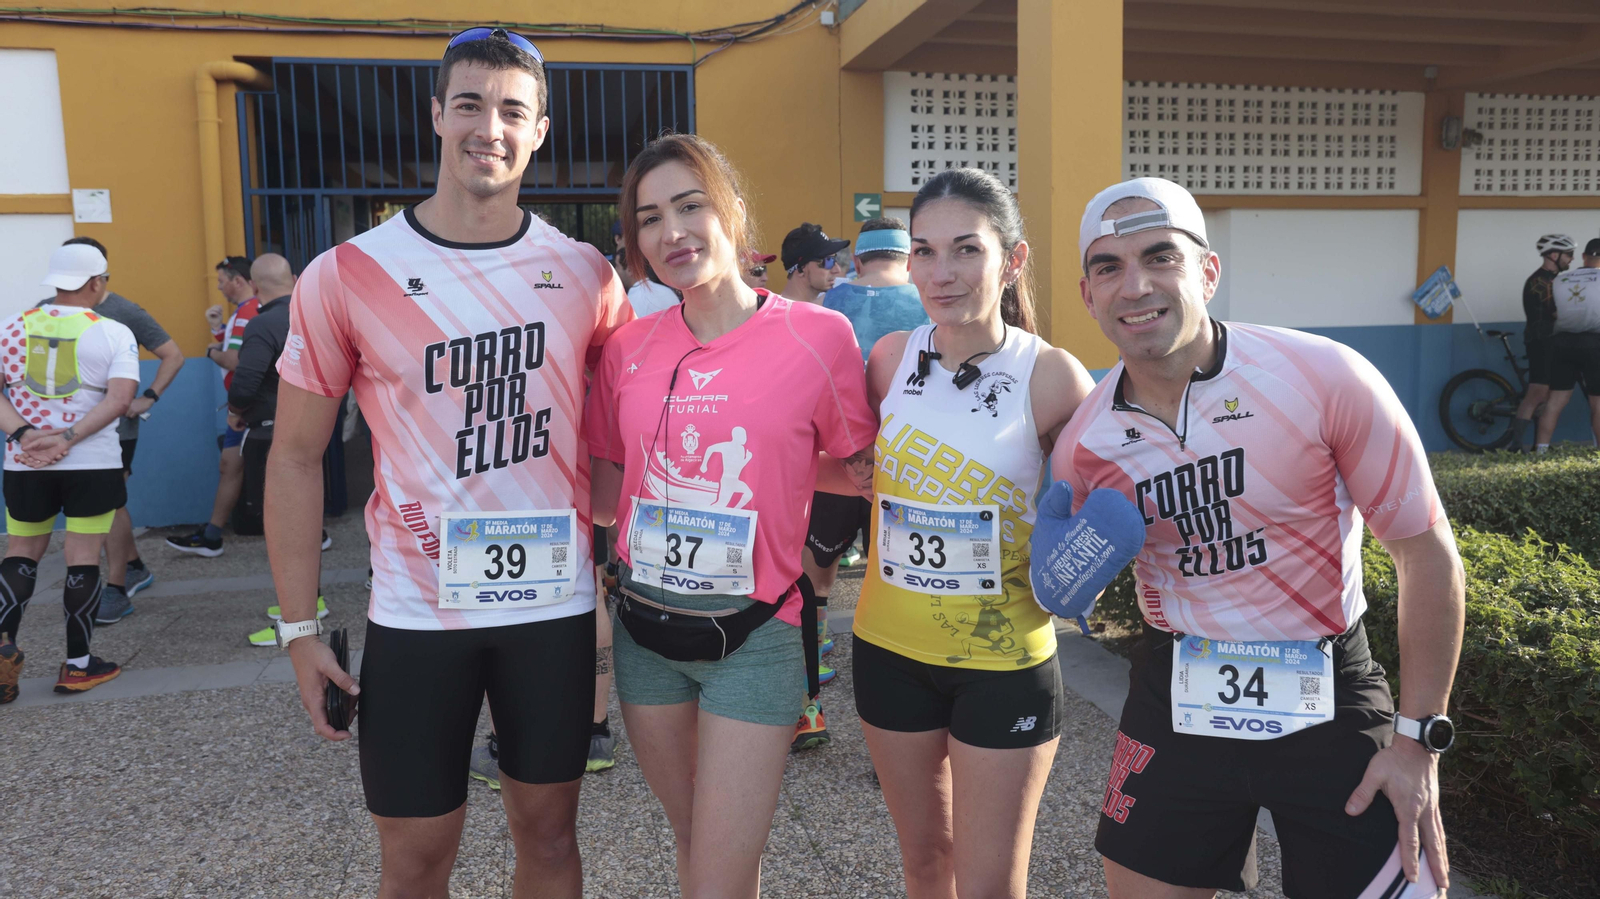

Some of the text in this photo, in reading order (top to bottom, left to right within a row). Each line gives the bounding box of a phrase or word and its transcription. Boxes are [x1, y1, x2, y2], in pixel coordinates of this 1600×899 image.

[424, 322, 546, 394] CORRO
[464, 372, 526, 428] POR
[662, 394, 728, 402] CUPRA
[668, 404, 718, 414] TURIAL
[1212, 411, 1254, 424] SPALL
[455, 407, 552, 480] ELLOS
[878, 413, 1028, 516] LIEBRES
[1134, 448, 1244, 526] CORRO
[398, 501, 430, 532] RUN
[485, 522, 537, 535] MARATÓN
[668, 514, 715, 529] MARATÓN
[908, 514, 955, 528] MARATÓN
[1173, 500, 1233, 546] POR
[484, 544, 526, 580] 39
[665, 533, 703, 569] 37
[909, 532, 946, 569] 33
[1055, 533, 1108, 586] INFANTIL
[1175, 528, 1268, 578] ELLOS
[476, 589, 537, 602] EVOS
[660, 574, 714, 590] EVOS
[904, 574, 960, 589] EVOS
[932, 612, 959, 637] LAS
[1218, 642, 1279, 658] MARATÓN
[1218, 664, 1268, 706] 34
[1209, 716, 1282, 734] EVOS
